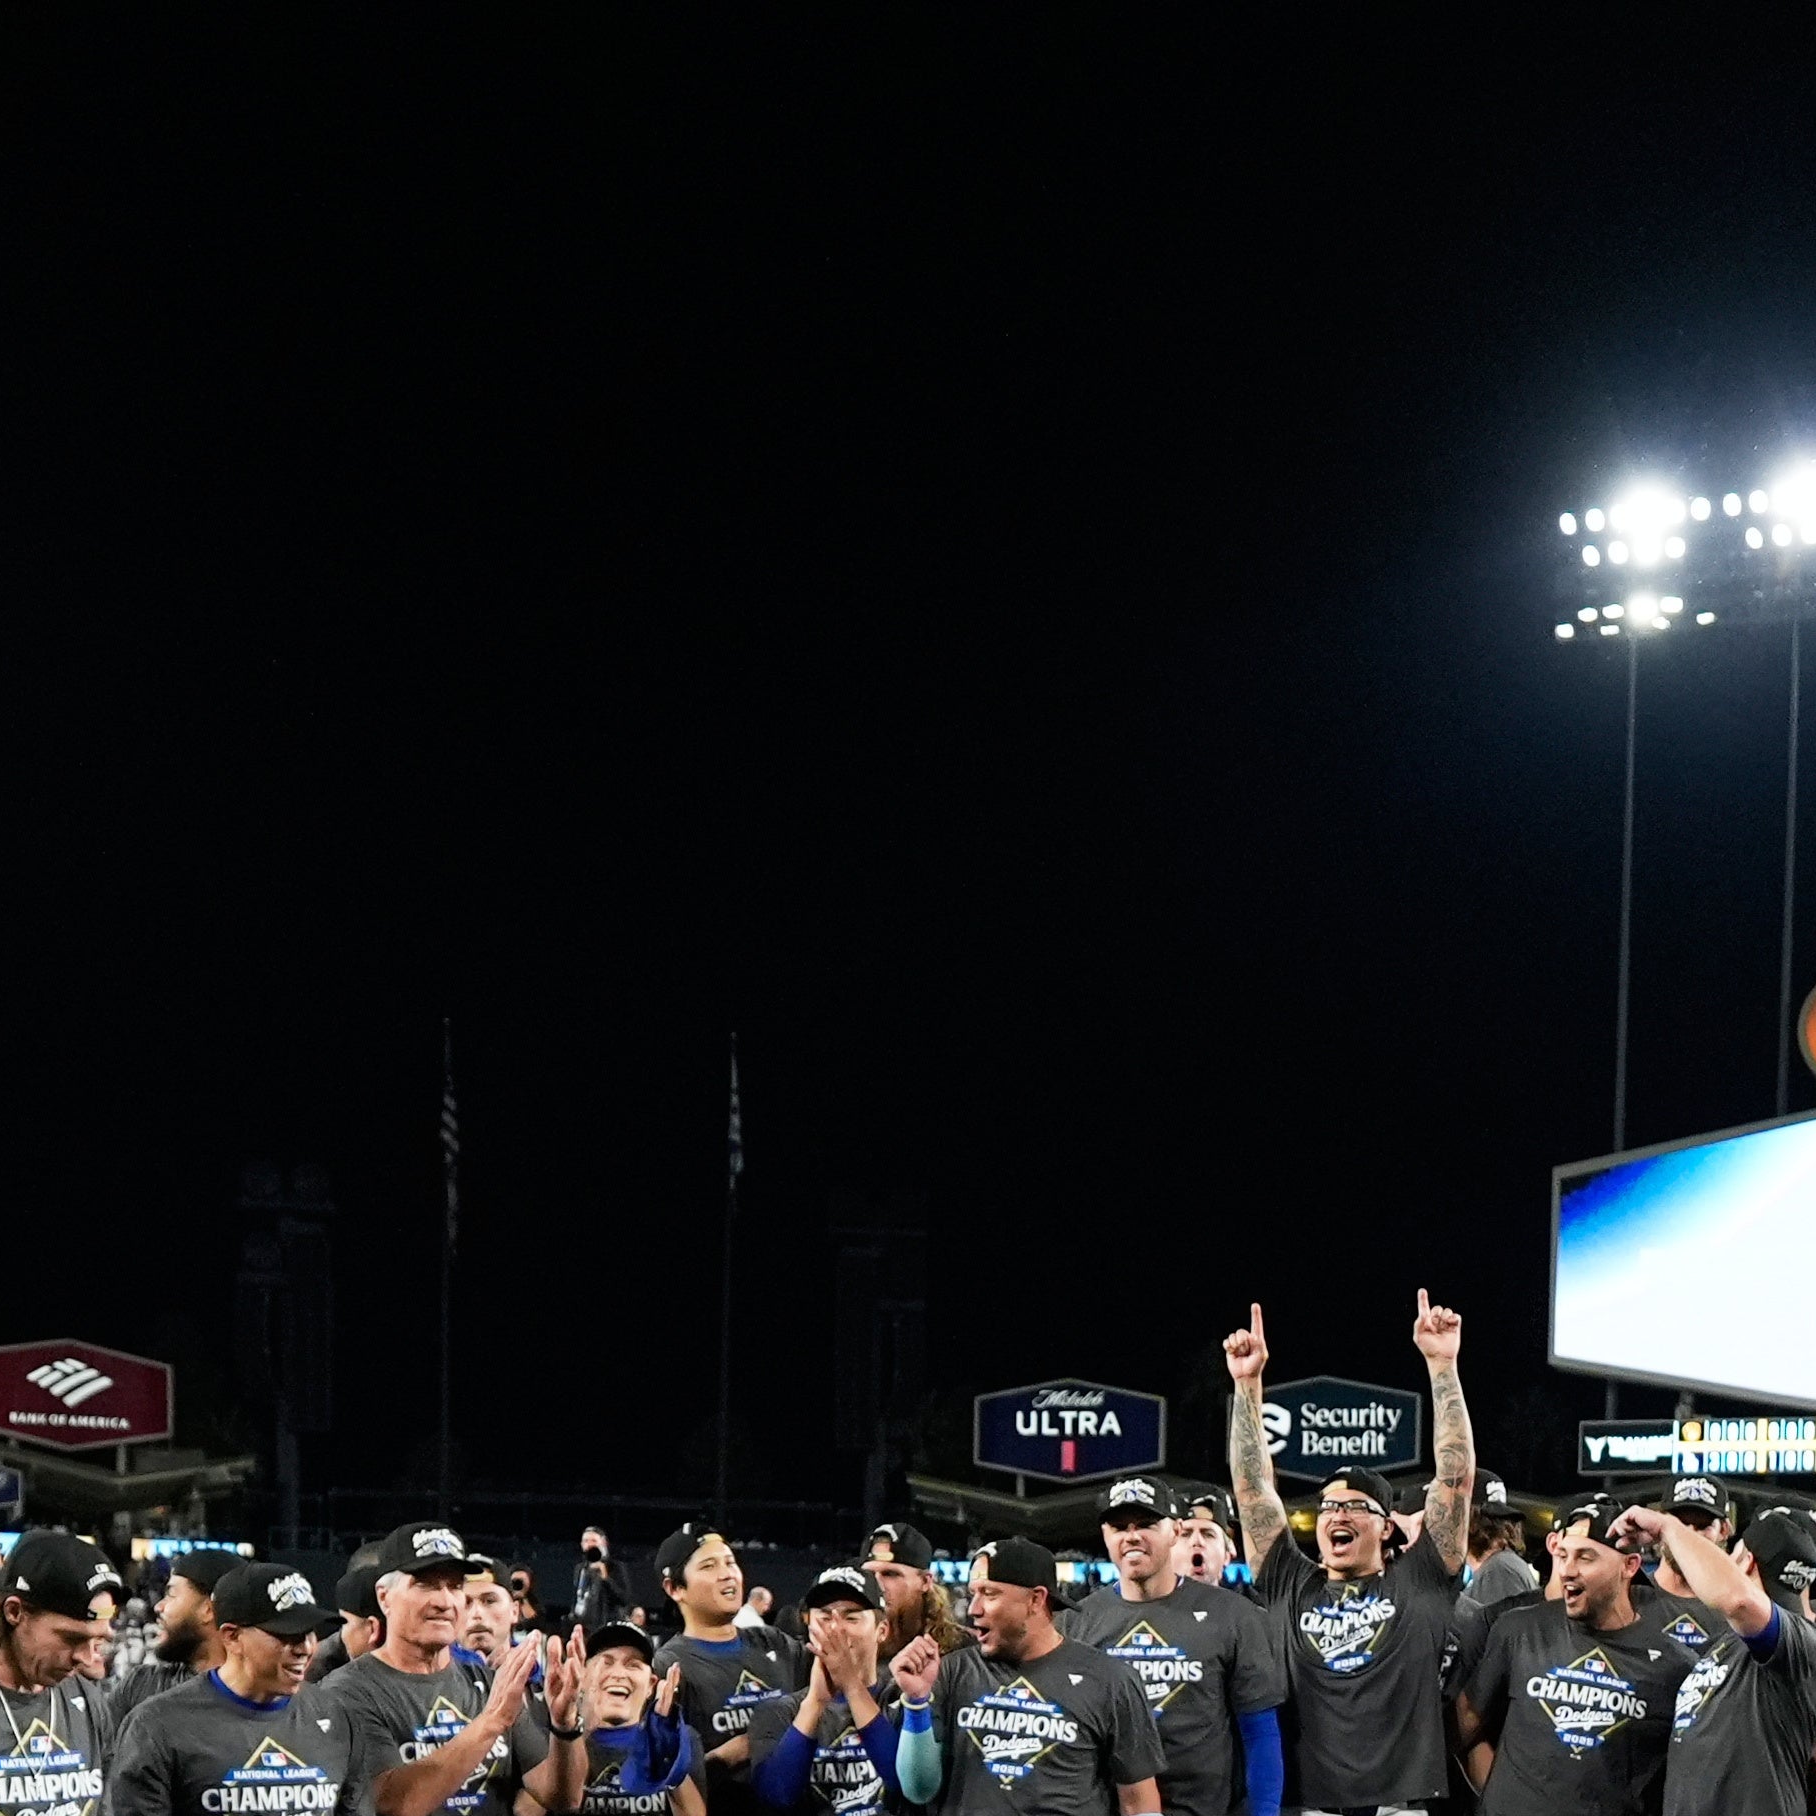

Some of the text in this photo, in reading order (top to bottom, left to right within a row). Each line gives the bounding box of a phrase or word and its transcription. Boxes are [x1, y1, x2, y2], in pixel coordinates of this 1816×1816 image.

[1015, 1410, 1123, 1437] ULTRA
[1300, 1401, 1403, 1433] Security
[1301, 1430, 1388, 1456] Benefit
[1300, 1598, 1396, 1636] CHAMPIONS
[1141, 1661, 1203, 1682] PIONS
[1526, 1675, 1647, 1719] CHAMPIONS
[956, 1707, 1079, 1744] CHAMPIONS
[1554, 1706, 1616, 1729] Dodgers
[982, 1734, 1044, 1761] Dodgers
[810, 1760, 876, 1784] HAMPI
[201, 1782, 340, 1815] CHAMPIONS
[586, 1790, 667, 1814] AMPION
